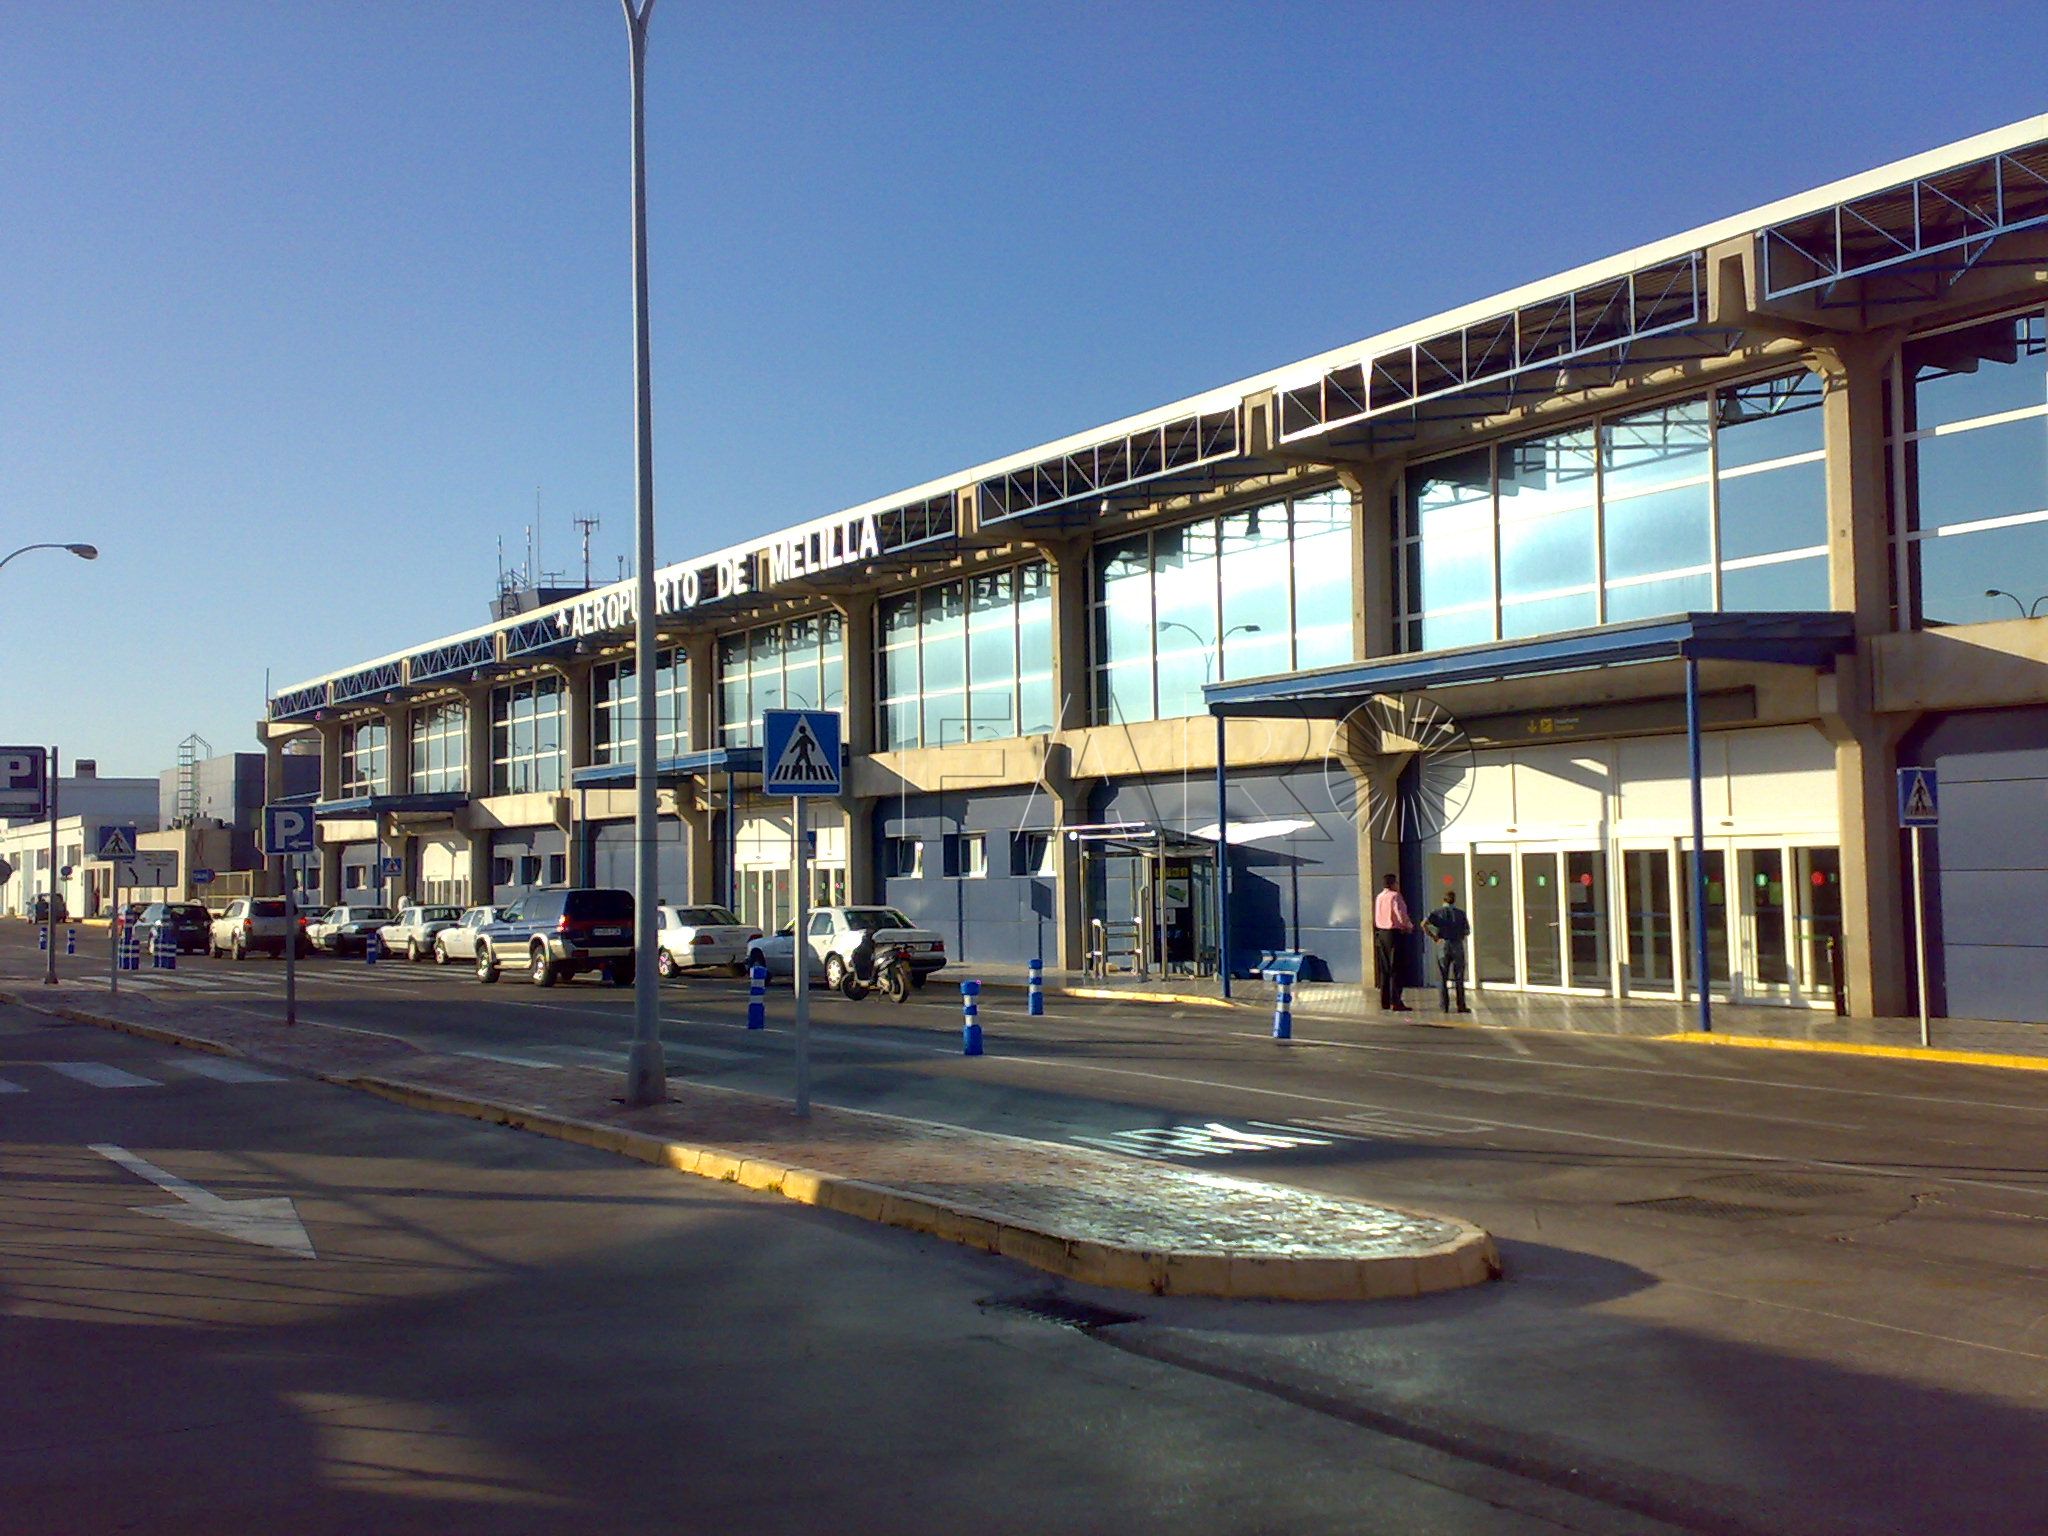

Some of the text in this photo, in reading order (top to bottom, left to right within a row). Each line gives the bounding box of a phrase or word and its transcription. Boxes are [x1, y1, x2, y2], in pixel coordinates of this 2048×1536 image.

[717, 554, 750, 598] DE
[769, 513, 879, 587] MELILLA
[275, 811, 304, 849] P
